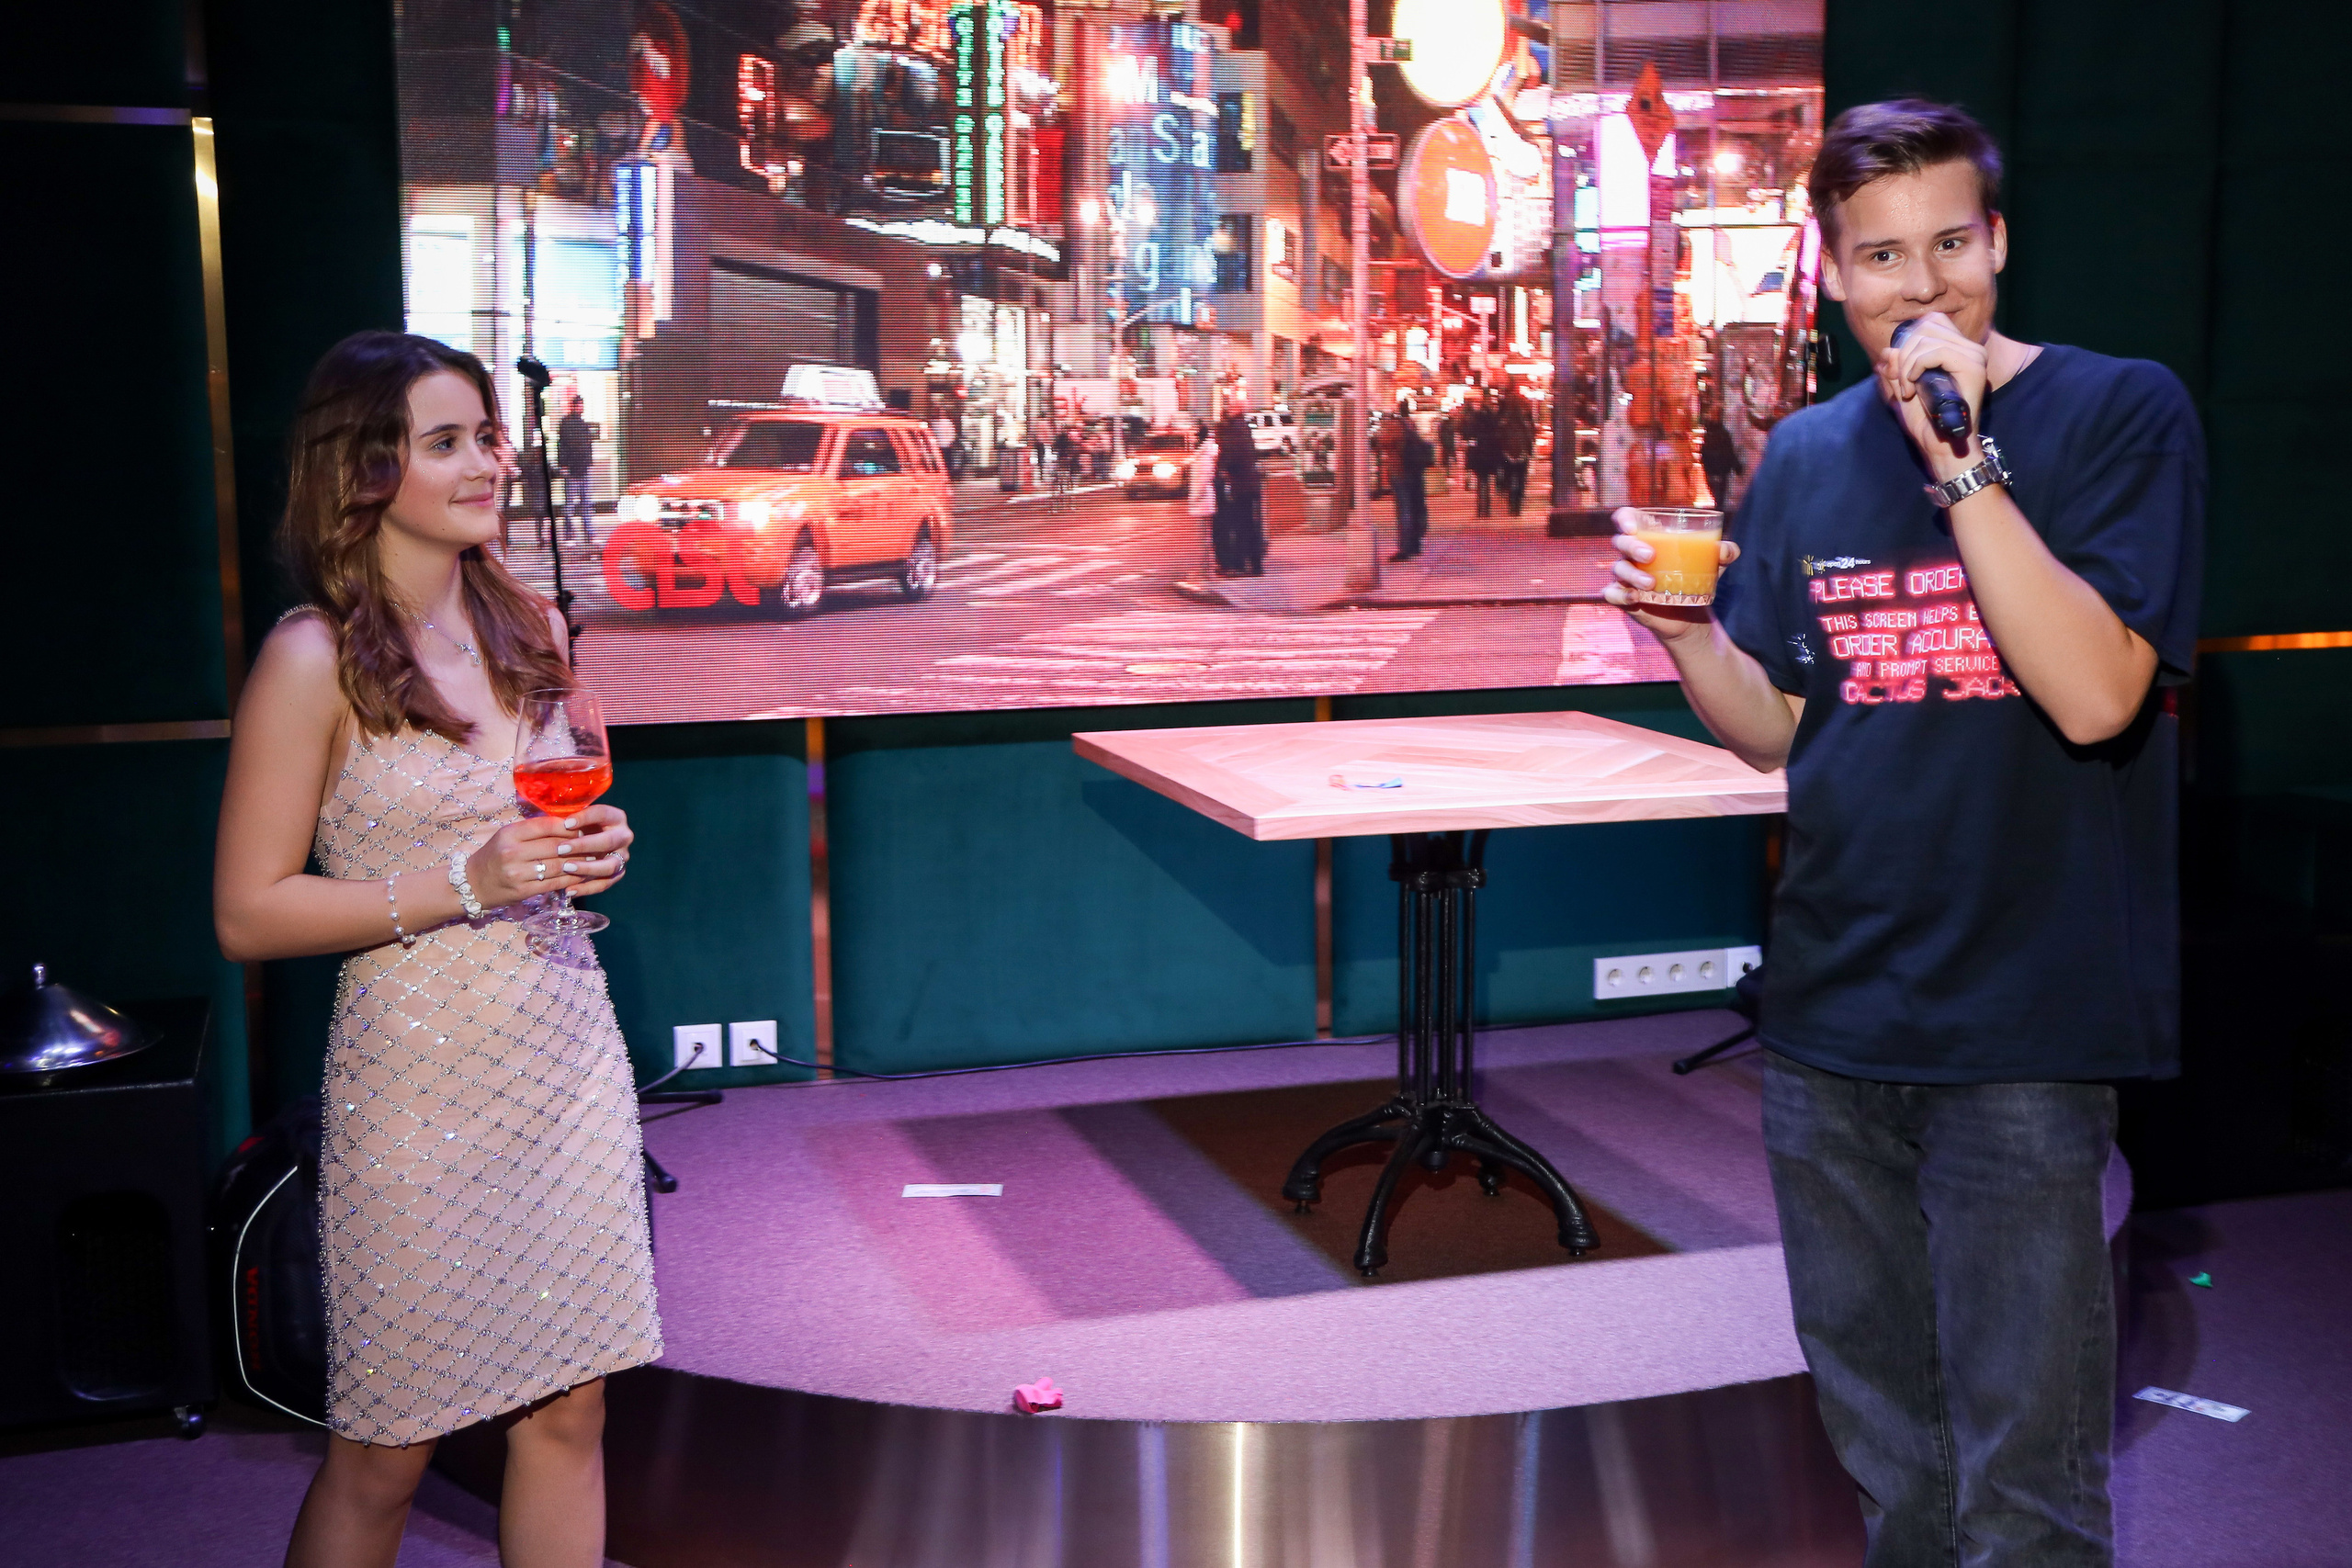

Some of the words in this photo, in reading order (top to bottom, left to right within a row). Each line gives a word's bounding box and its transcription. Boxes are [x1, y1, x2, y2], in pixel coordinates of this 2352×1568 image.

[1826, 560, 1841, 569] open
[1840, 557, 1856, 570] 24
[1814, 573, 1894, 604] PLEASE
[1822, 614, 1859, 633] THIS
[1864, 611, 1917, 629] SCREEN
[1922, 605, 1959, 625] HELPS
[1833, 634, 1898, 657] ORDER
[1856, 661, 1872, 678] AND
[1880, 660, 1928, 678] PROMPT
[1935, 655, 1999, 673] SERVICE
